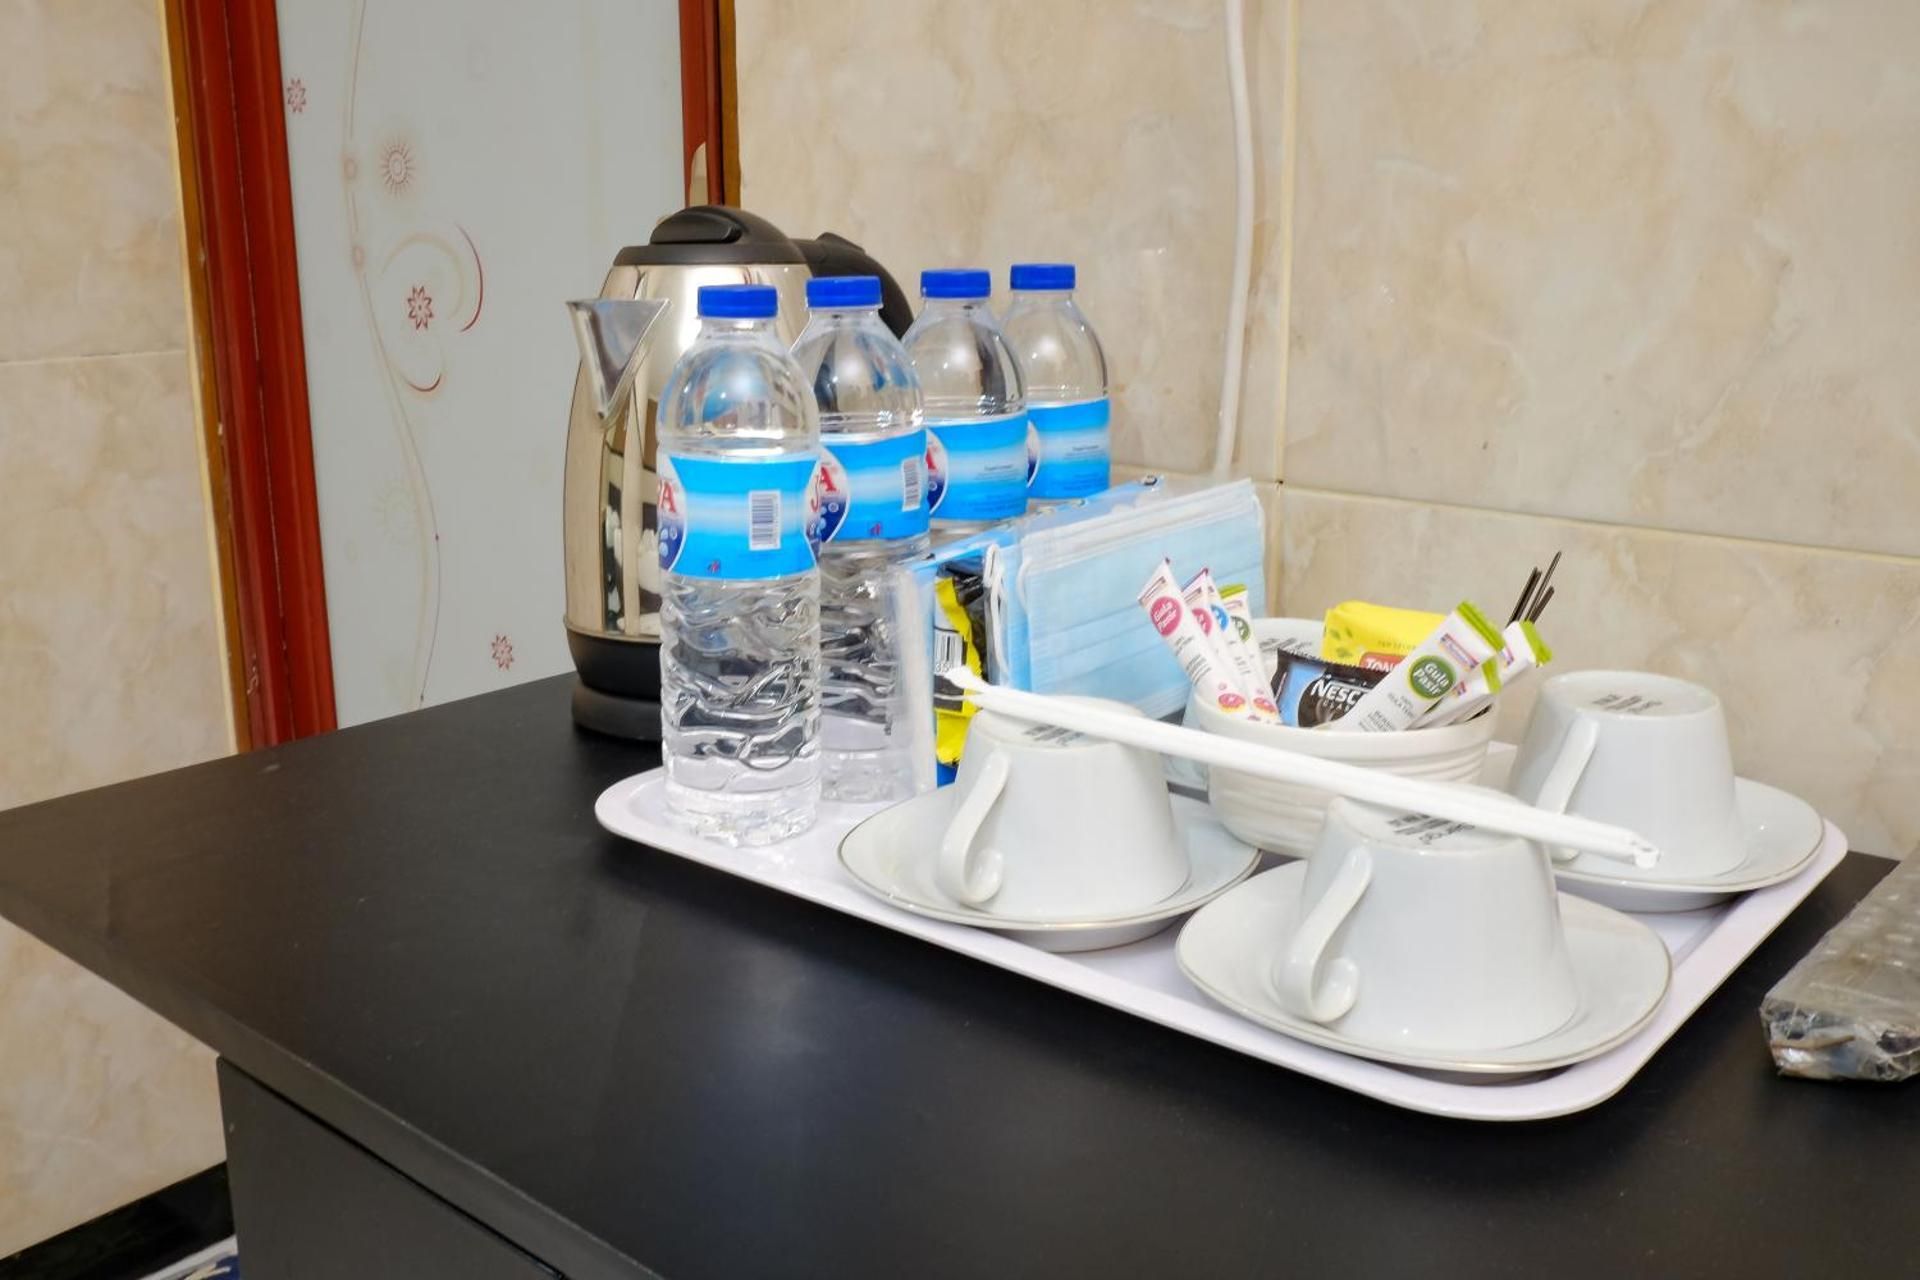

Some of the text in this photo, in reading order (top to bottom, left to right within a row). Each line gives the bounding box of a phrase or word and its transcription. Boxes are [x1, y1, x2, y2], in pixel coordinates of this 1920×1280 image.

[1412, 668, 1441, 695] Pasir
[1424, 662, 1450, 687] Gula
[1310, 678, 1363, 706] NESC
